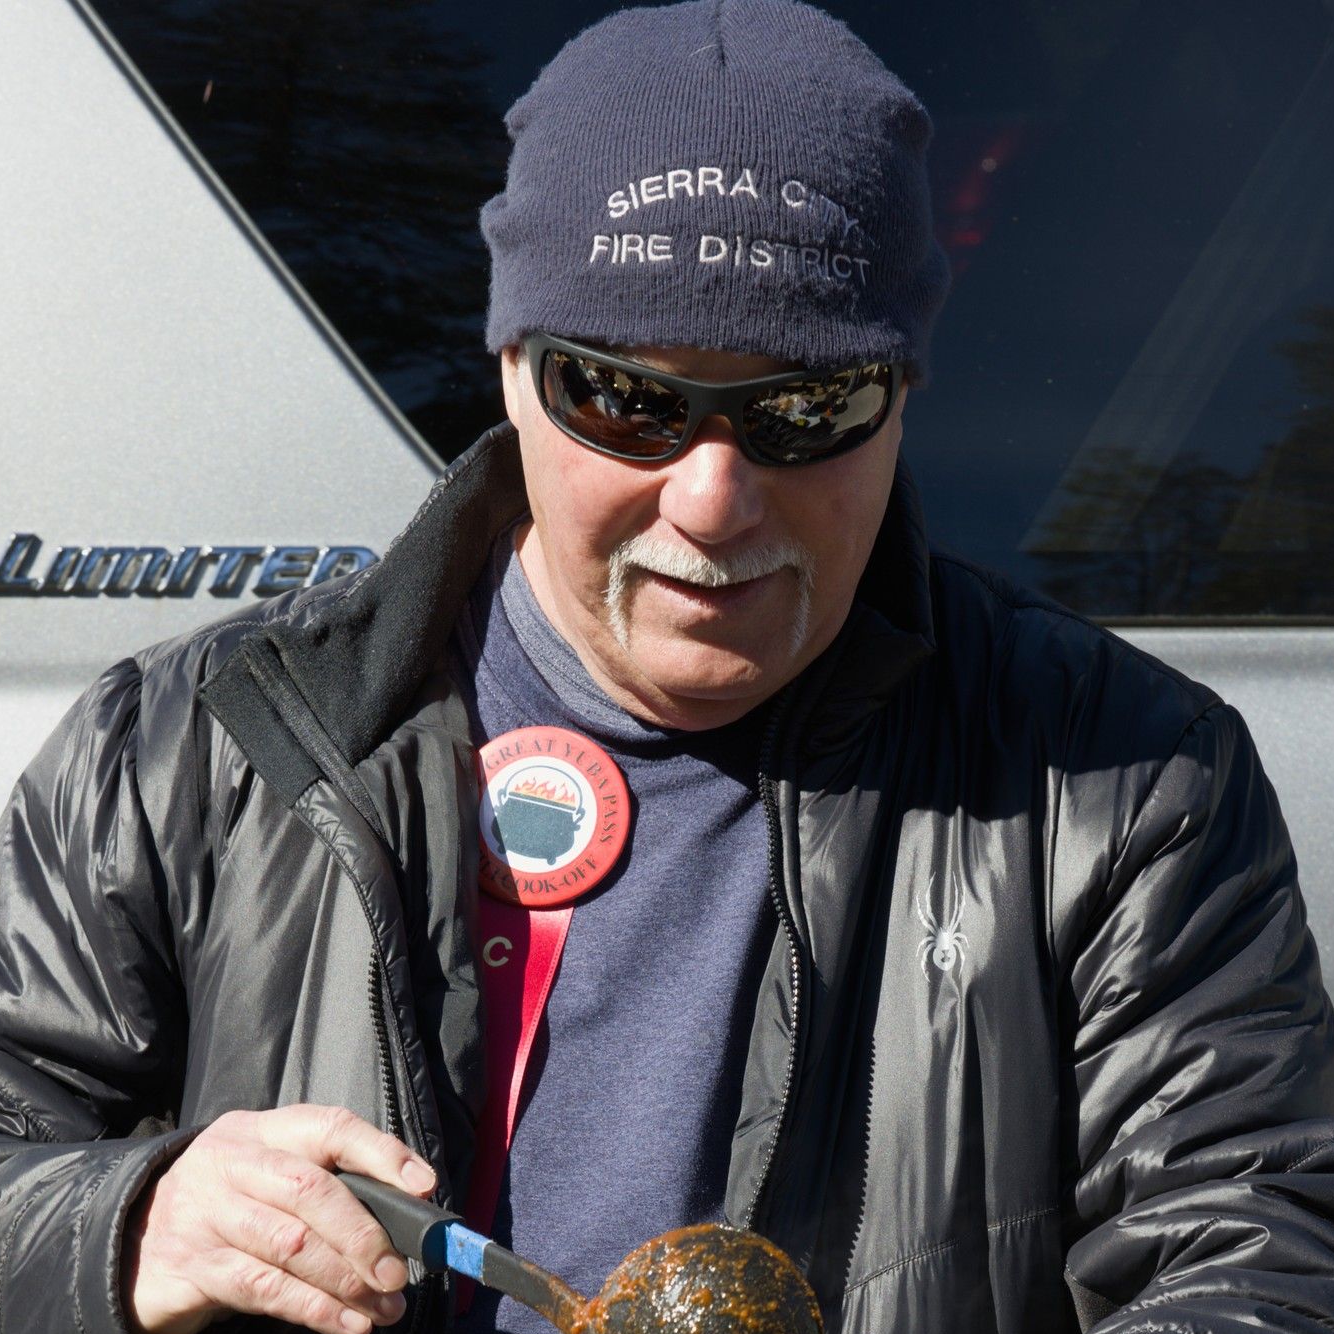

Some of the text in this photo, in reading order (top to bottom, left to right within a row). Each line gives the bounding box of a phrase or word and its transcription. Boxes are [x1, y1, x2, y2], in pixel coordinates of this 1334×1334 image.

[606, 167, 758, 218] SIERRA
[589, 233, 870, 285] FIRE DISTRICT
[484, 738, 617, 844] GREAT YUBA PASS
[502, 854, 597, 894] COOK-OFF
